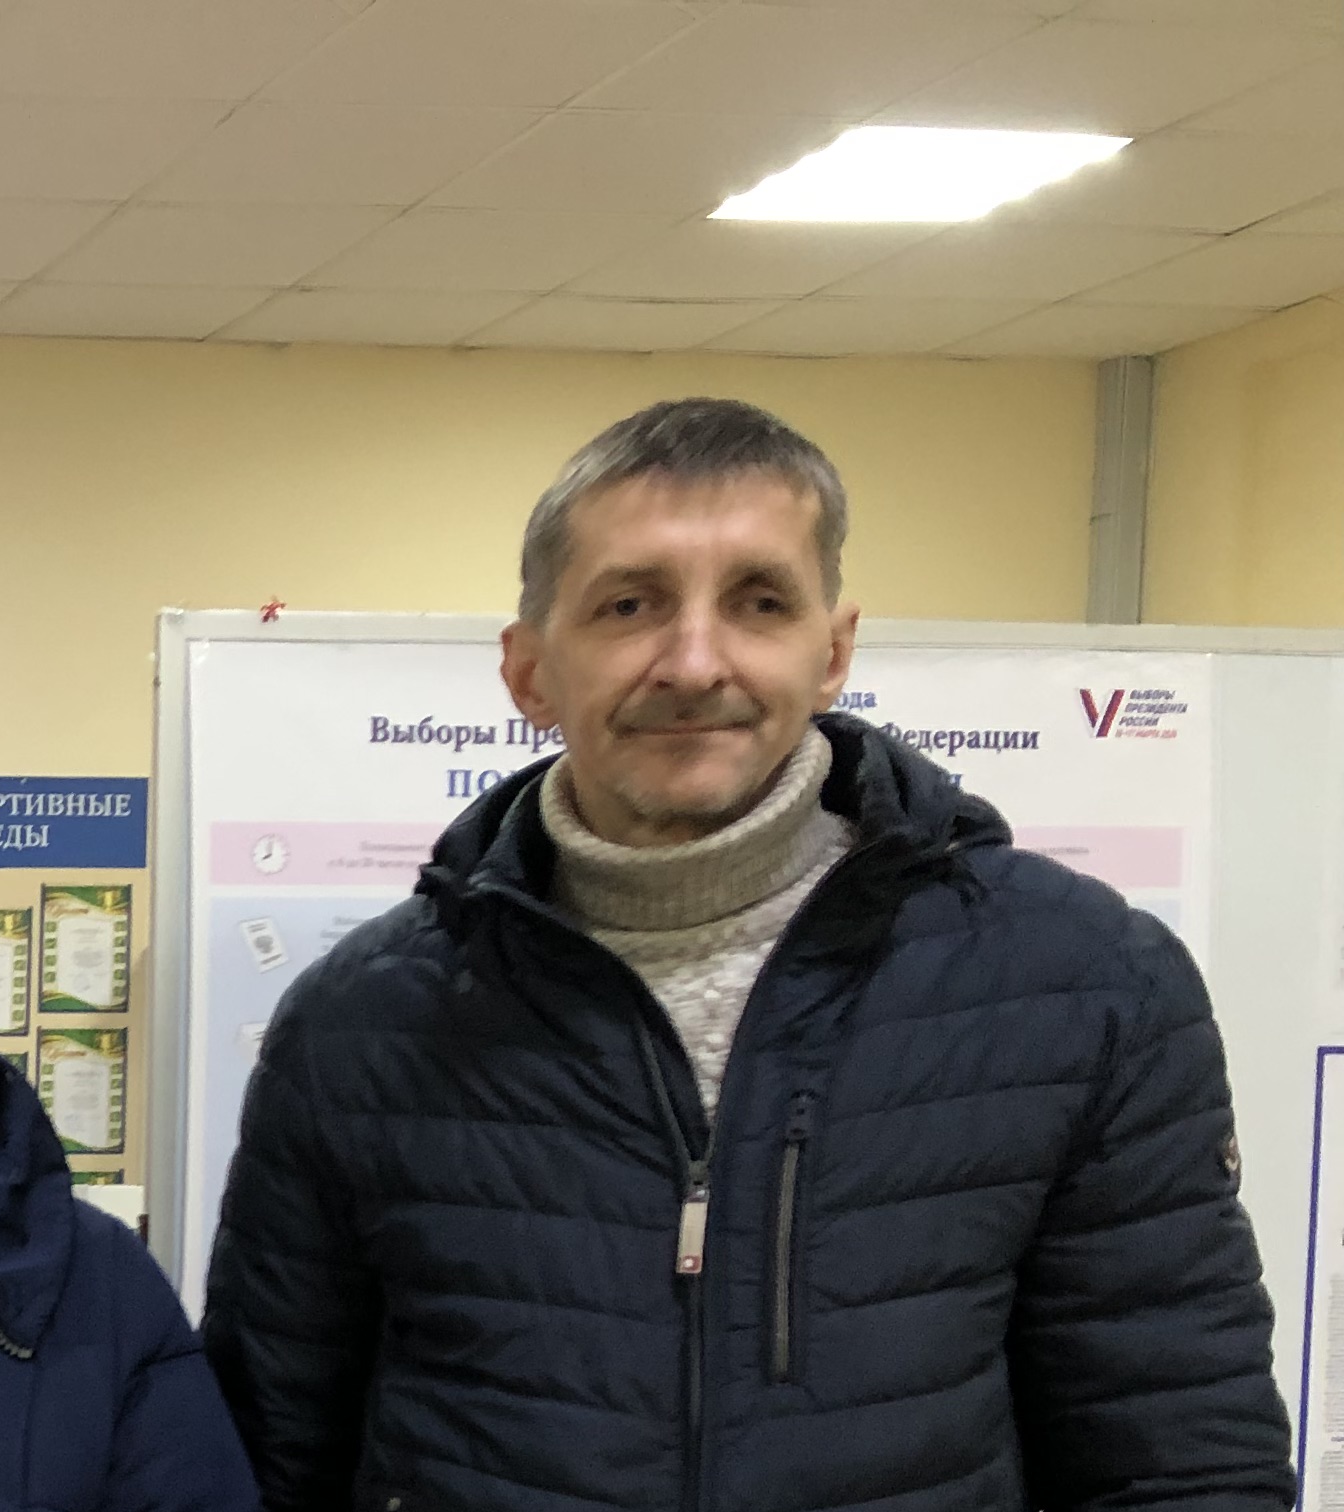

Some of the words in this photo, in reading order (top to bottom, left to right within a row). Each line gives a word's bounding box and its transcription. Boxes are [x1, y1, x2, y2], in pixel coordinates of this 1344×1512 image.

[834, 691, 877, 711] ода
[368, 715, 496, 752] Выборы
[505, 717, 565, 753] Пре
[446, 769, 502, 798] ПО
